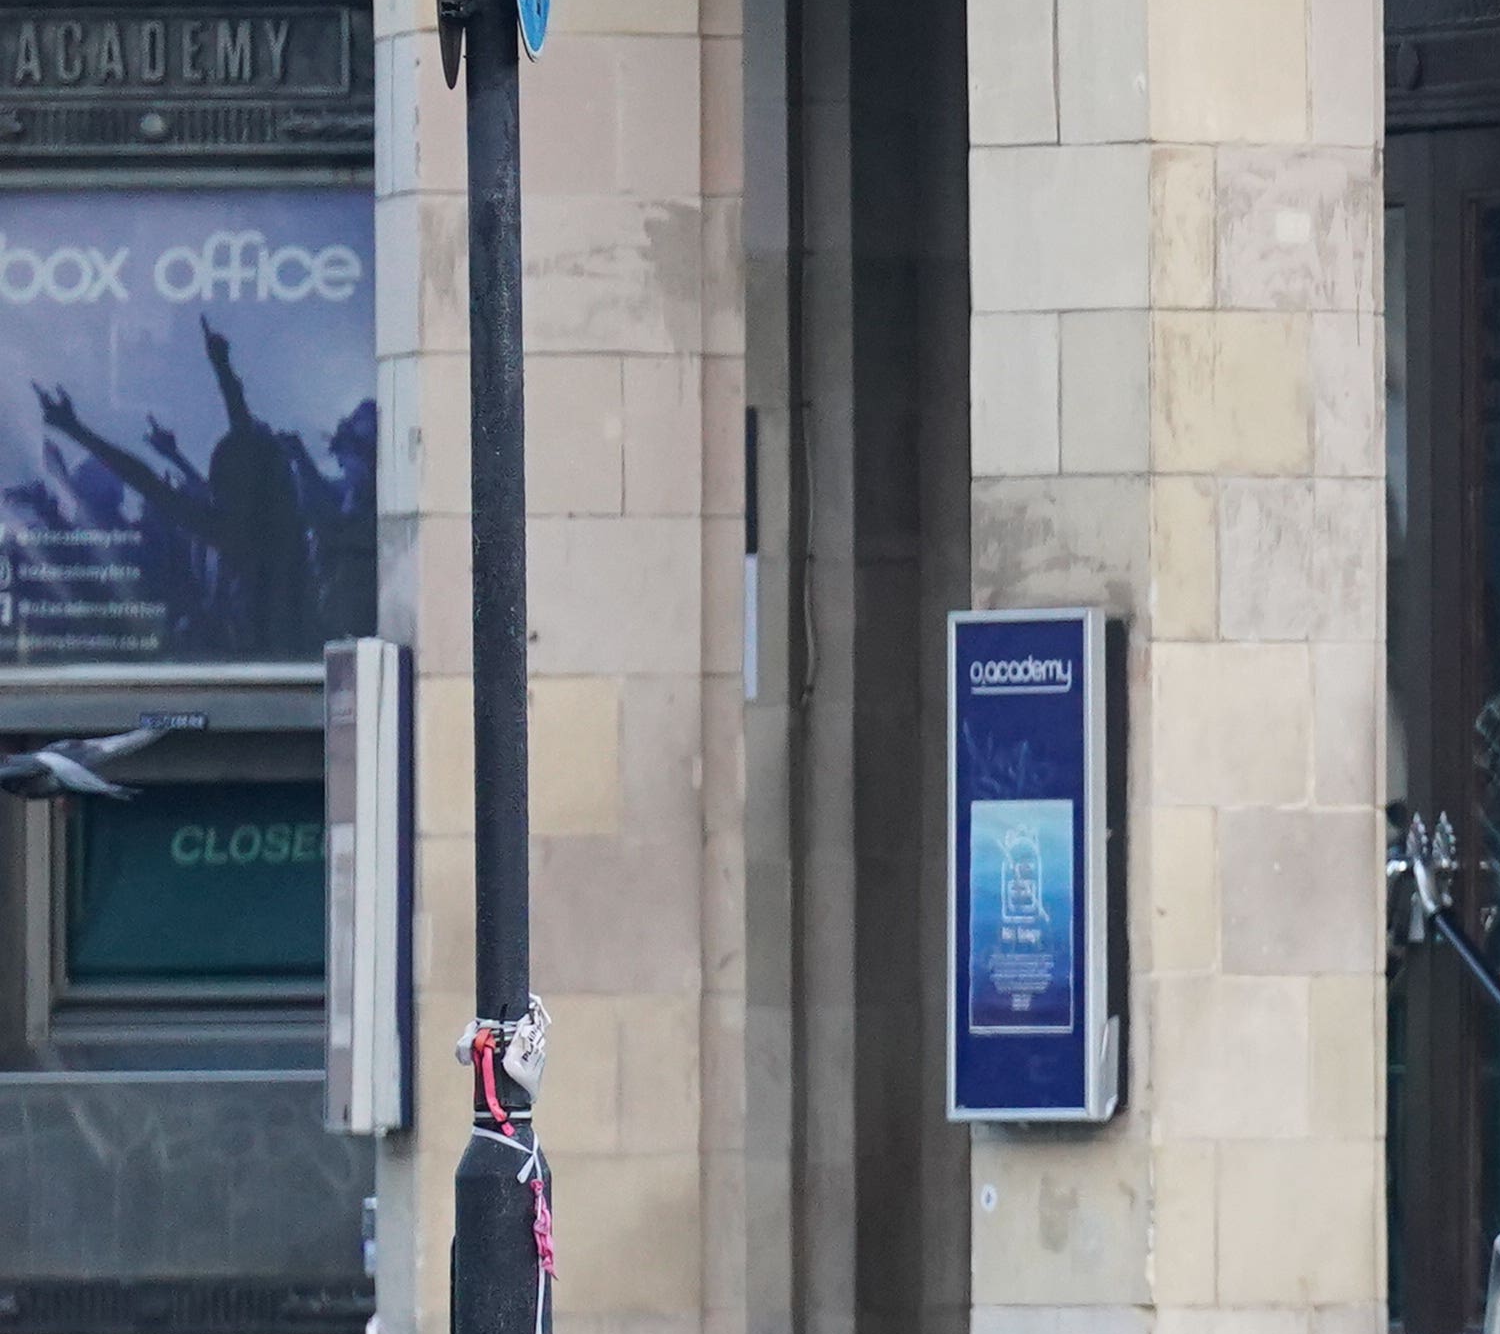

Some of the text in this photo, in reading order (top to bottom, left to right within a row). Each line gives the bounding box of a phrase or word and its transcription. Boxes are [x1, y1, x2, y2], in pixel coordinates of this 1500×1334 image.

[14, 18, 291, 87] ACADEMY
[153, 228, 364, 303] office
[170, 822, 326, 866] CLOSE
